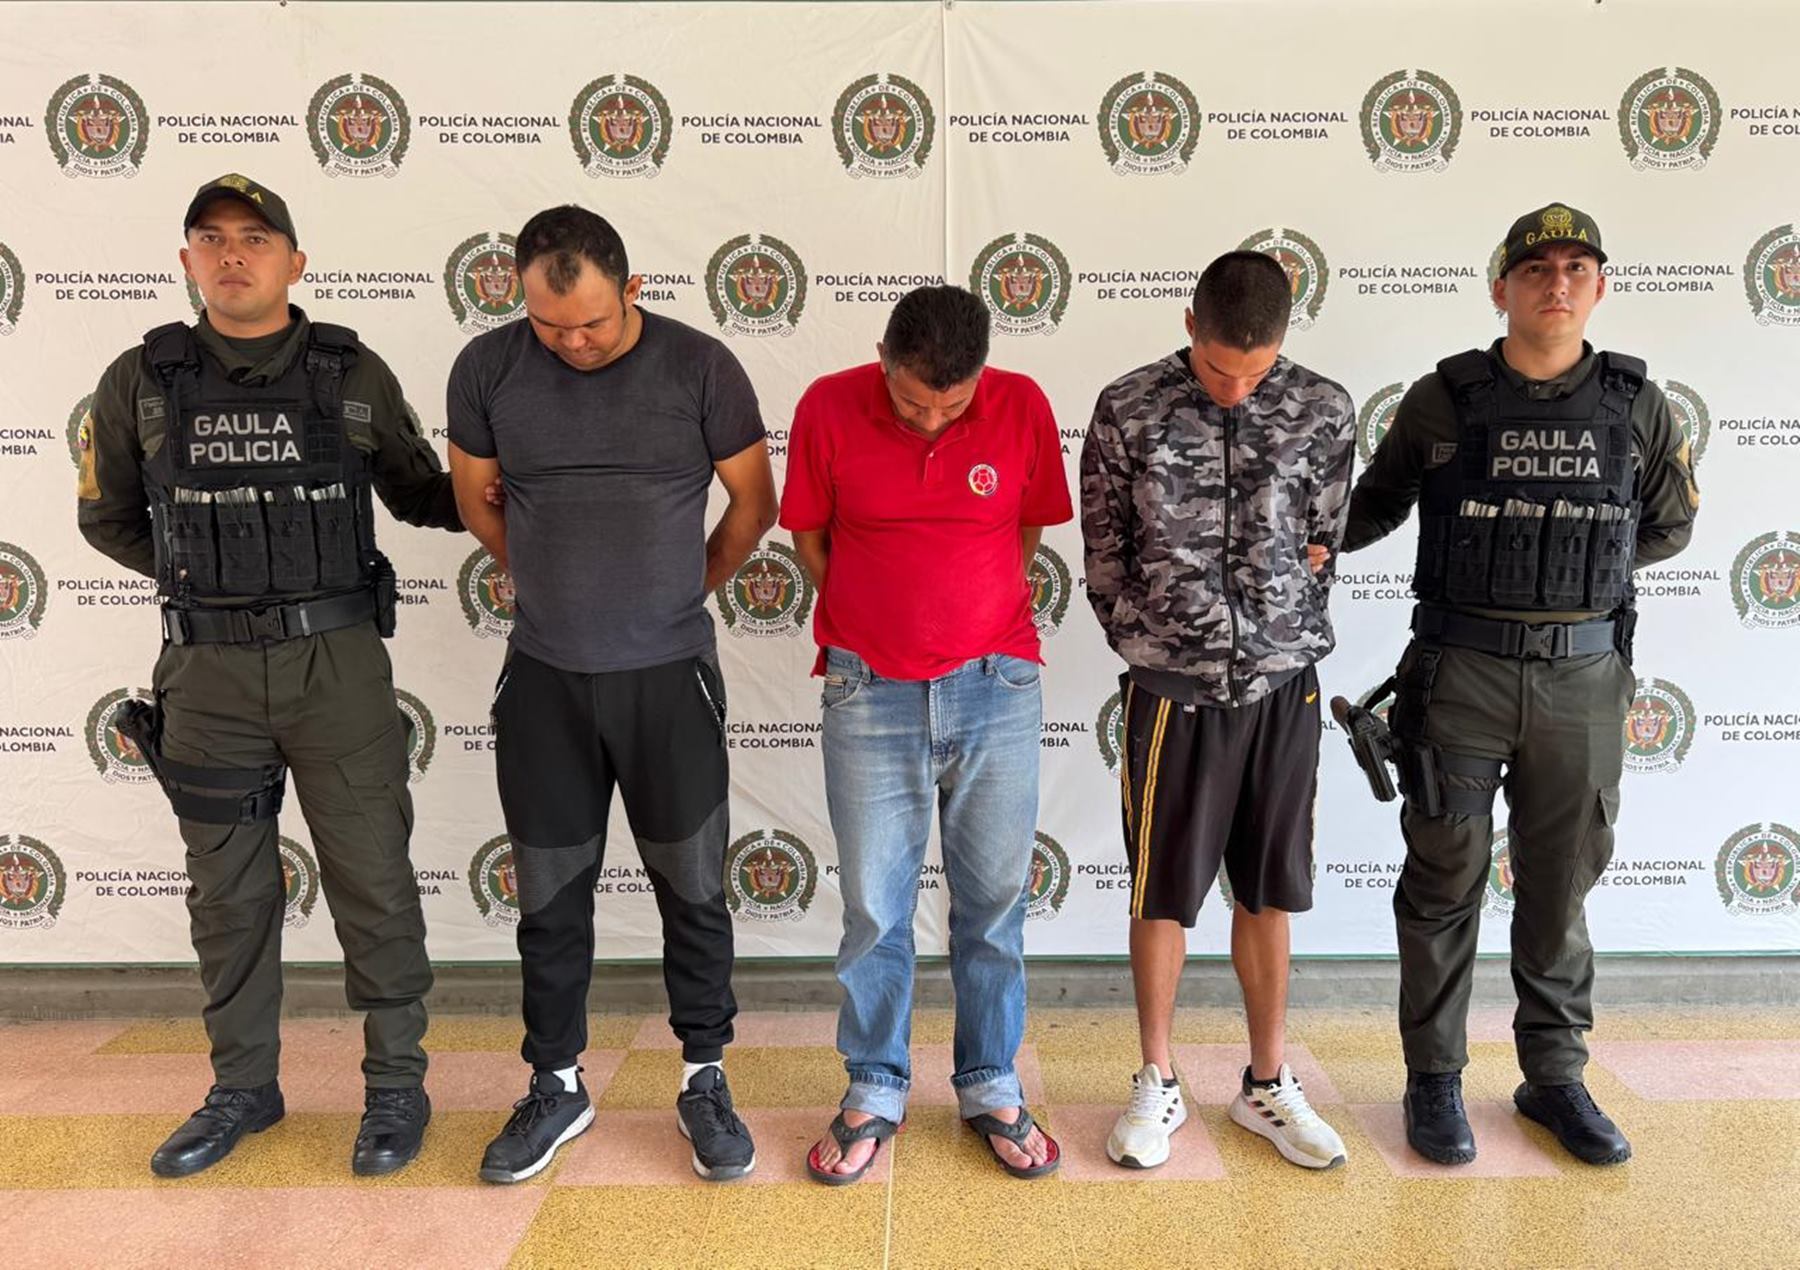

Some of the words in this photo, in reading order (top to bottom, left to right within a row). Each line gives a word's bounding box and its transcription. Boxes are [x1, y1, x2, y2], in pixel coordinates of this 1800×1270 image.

[1207, 109, 1268, 124] POLICÍA
[1269, 111, 1349, 124] NACIONAL
[1470, 107, 1530, 122] POLICÍA
[1532, 109, 1612, 122] NACIONAL
[1729, 105, 1790, 120] POLICÍA
[157, 112, 218, 128] POLICÍA
[220, 115, 300, 128] NACIONAL
[418, 112, 480, 128] POLICÍA
[481, 115, 562, 128] NACIONAL
[680, 112, 741, 128] POLICÍA
[743, 115, 823, 128] NACIONAL
[949, 112, 1009, 127] POLICÍA
[1011, 114, 1091, 126] NACIONAL
[1226, 127, 1247, 140] DE
[1249, 127, 1329, 140] COLOMBIA
[1489, 126, 1510, 138] DE
[1511, 125, 1591, 138] COLOMBIA
[1748, 123, 1769, 136] DE
[177, 131, 199, 144] DE
[201, 131, 281, 144] COLOMBIA
[438, 131, 460, 144] DE
[461, 131, 542, 144] COLOMBIA
[700, 132, 721, 144] DE
[723, 131, 804, 144] COLOMBIA
[968, 130, 989, 143] DE
[991, 130, 1071, 143] COLOMBIA
[1525, 227, 1589, 246] GAULA
[1338, 264, 1398, 280] POLICÍA
[1400, 266, 1479, 279] NACIONAL
[1602, 261, 1654, 277] OLICÍA
[1655, 264, 1736, 277] NACIONAL
[34, 269, 95, 285] POLICÍA
[97, 272, 177, 285] NACIONAL
[303, 269, 354, 284] OLICÍA
[355, 271, 436, 284] NACIONAL
[639, 273, 696, 285] CIONAL
[815, 271, 875, 287] POLICÍA
[876, 274, 946, 287] NACIONA
[1077, 268, 1138, 284] POLICÍA
[1139, 270, 1200, 283] NACION
[1357, 282, 1378, 295] DE
[1380, 282, 1459, 295] COLOMBIA
[1612, 280, 1633, 293] DE
[1635, 280, 1715, 293] COLOMBIA
[55, 288, 76, 301] DE
[77, 288, 159, 301] COLOMBIA
[313, 287, 334, 300] DE
[336, 287, 417, 300] COLOMBIA
[834, 290, 855, 303] DE
[1096, 287, 1117, 300] DE
[193, 412, 293, 437] GAULA
[1718, 415, 1777, 431] POLICÍA
[0, 428, 56, 440] CIONAL
[1500, 428, 1597, 452] GAULA
[1736, 434, 1757, 447] DE
[1759, 434, 1800, 447] COLO
[189, 439, 301, 464] POLICIA
[1491, 454, 1601, 478] POLICIA
[1333, 571, 1391, 585] POLICÍA
[1644, 569, 1722, 582] NACIONAL
[56, 576, 116, 591] POLICÍA
[1351, 589, 1371, 601] DE
[1634, 585, 1702, 598] OLOMBIA
[76, 594, 97, 606] DE
[1703, 711, 1761, 727] POLICÍA
[758, 722, 824, 734] NACIONA
[1721, 730, 1741, 742] DE
[0, 741, 57, 753] LOMBIA
[463, 740, 483, 752] DE
[739, 737, 816, 750] COLOMBIA
[1325, 860, 1384, 875] POLICÍA
[1631, 859, 1707, 872] NACIONAL
[75, 868, 134, 883] POLICÍA
[1612, 875, 1687, 887] COLOMBIA
[1095, 878, 1115, 890] DE
[1344, 877, 1364, 889] DE
[95, 885, 115, 897] DE
